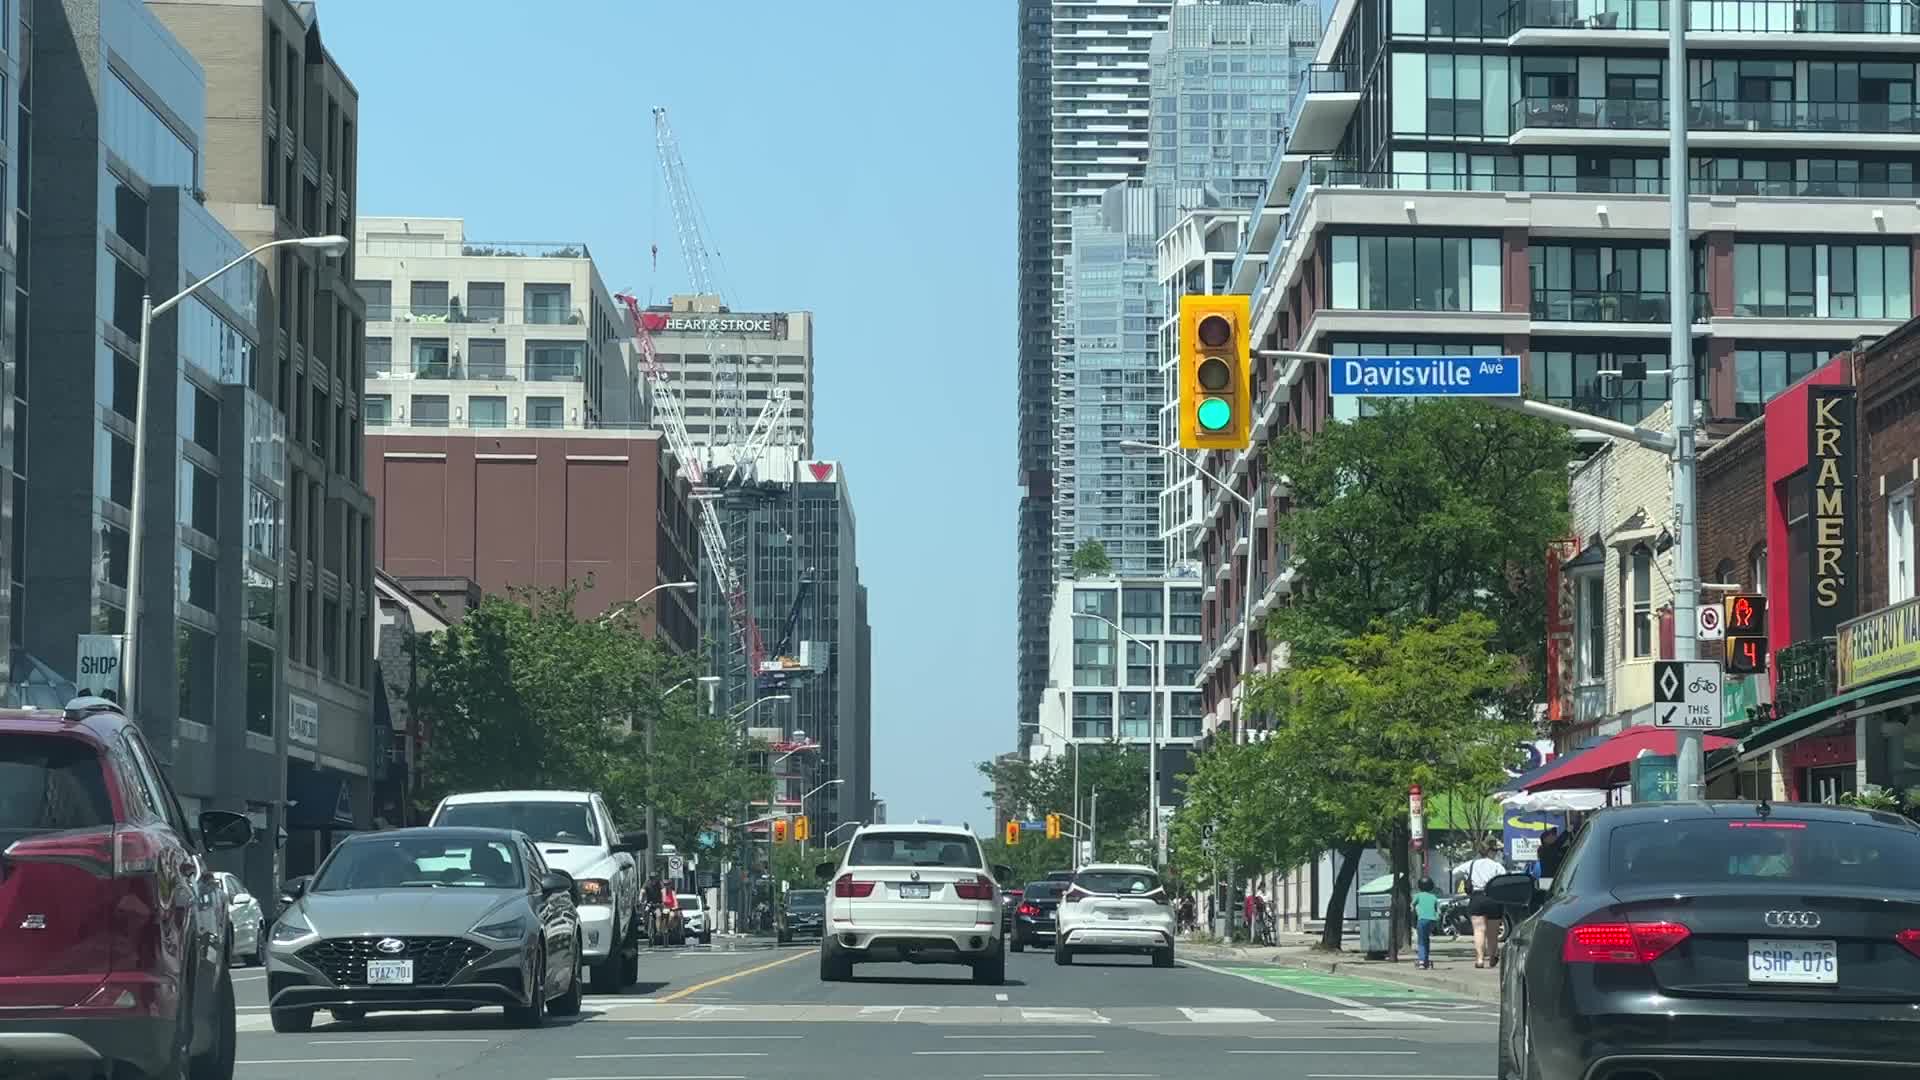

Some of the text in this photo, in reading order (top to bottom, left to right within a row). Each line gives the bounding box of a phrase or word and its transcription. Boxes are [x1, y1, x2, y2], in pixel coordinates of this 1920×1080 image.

[1345, 361, 1504, 386] Davisville Ave
[1815, 398, 1844, 607] KRAMER'S
[1852, 616, 1880, 661] FRESH
[1882, 610, 1901, 652] BUY
[81, 656, 117, 674] SHOP
[1743, 642, 1756, 667] 4
[1684, 716, 1713, 726] LANE
[1687, 705, 1710, 715] THIS
